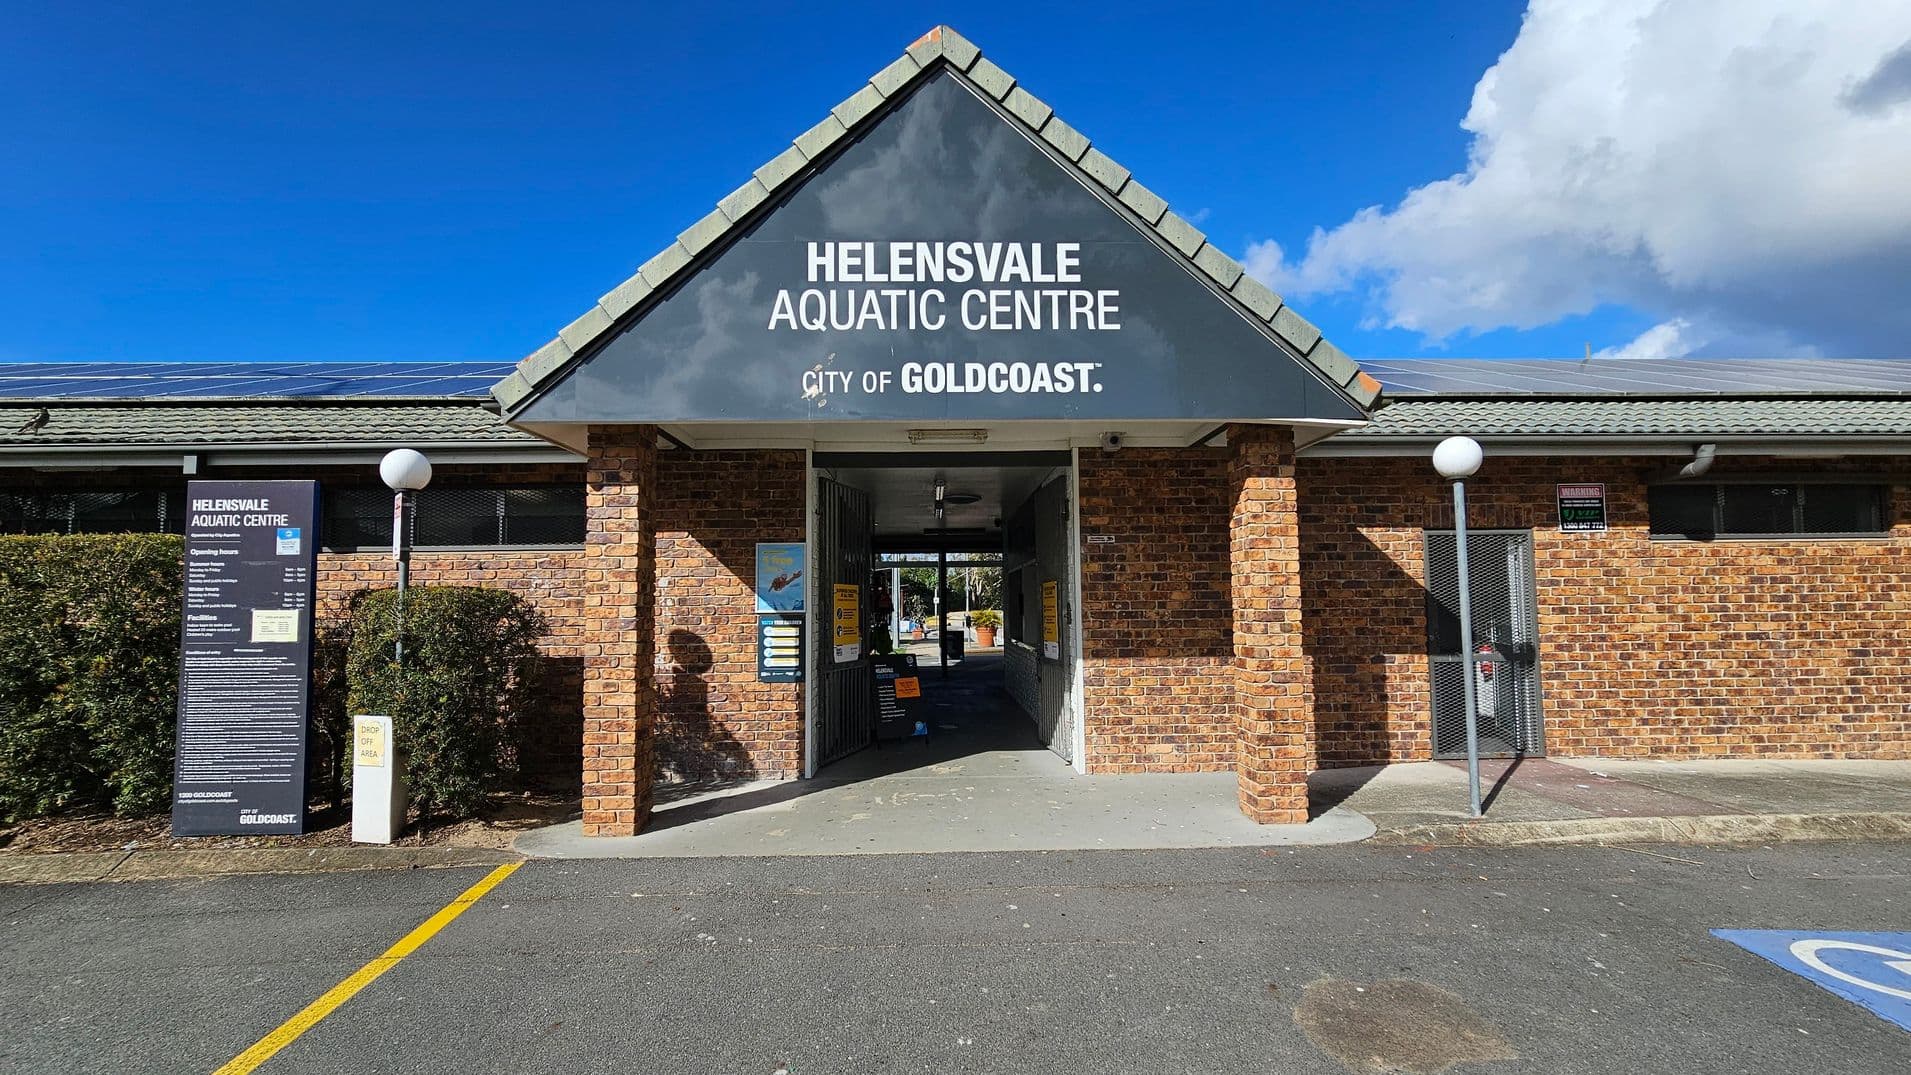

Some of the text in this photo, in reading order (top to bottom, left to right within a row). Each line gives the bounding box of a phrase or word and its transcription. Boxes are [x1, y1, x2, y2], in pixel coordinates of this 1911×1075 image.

[807, 242, 1081, 282] HELENSVALE
[768, 289, 1121, 331] AQUATIC CENTRE
[802, 370, 853, 394] CITY
[862, 370, 892, 394] OF
[1561, 488, 1600, 496] WARNING
[192, 499, 269, 511] HELENSVALE
[191, 514, 288, 527] AQUATIC CENTRE
[361, 726, 379, 734] DROP
